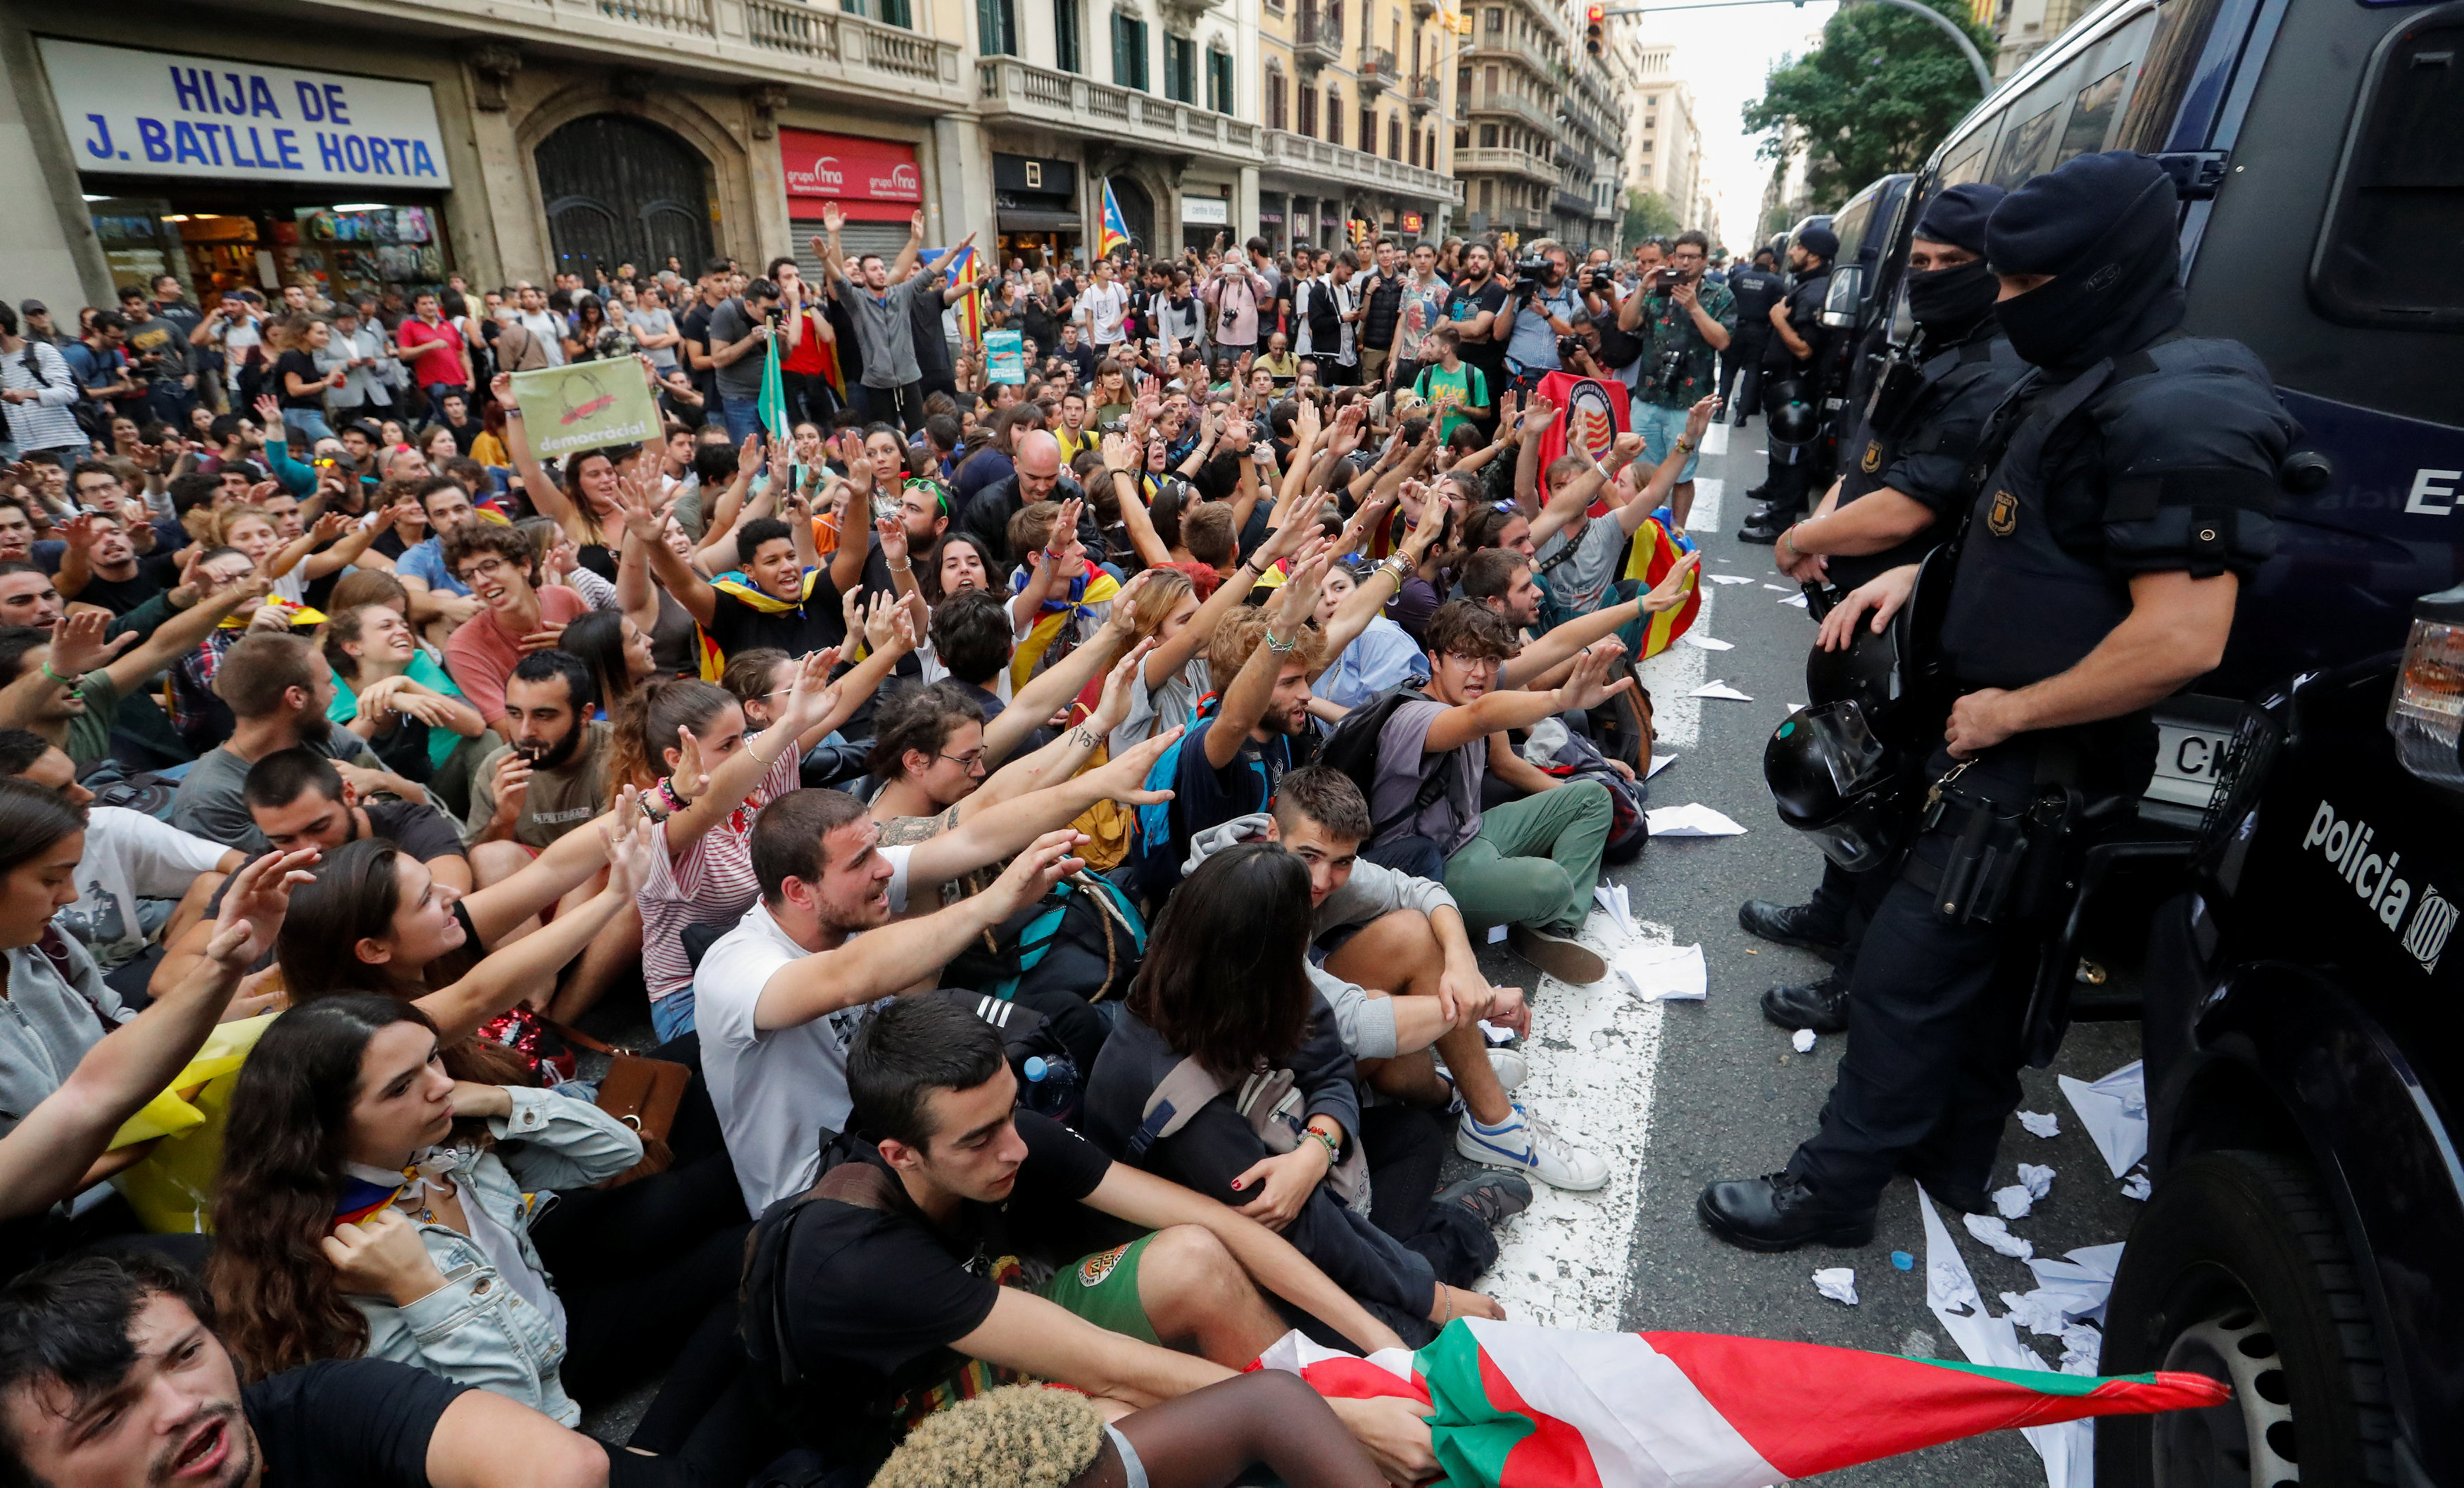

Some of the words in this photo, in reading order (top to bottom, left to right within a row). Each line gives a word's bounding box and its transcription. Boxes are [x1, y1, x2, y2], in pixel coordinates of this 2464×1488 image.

[169, 65, 283, 120] HIJA
[294, 80, 352, 127] DE
[85, 113, 130, 161] J.
[136, 117, 304, 170] BATLLE
[317, 131, 439, 177] HORTA
[787, 170, 815, 184] grupo
[869, 177, 893, 189] grupo
[539, 420, 648, 453] democràcia!
[2302, 799, 2411, 933] policia
